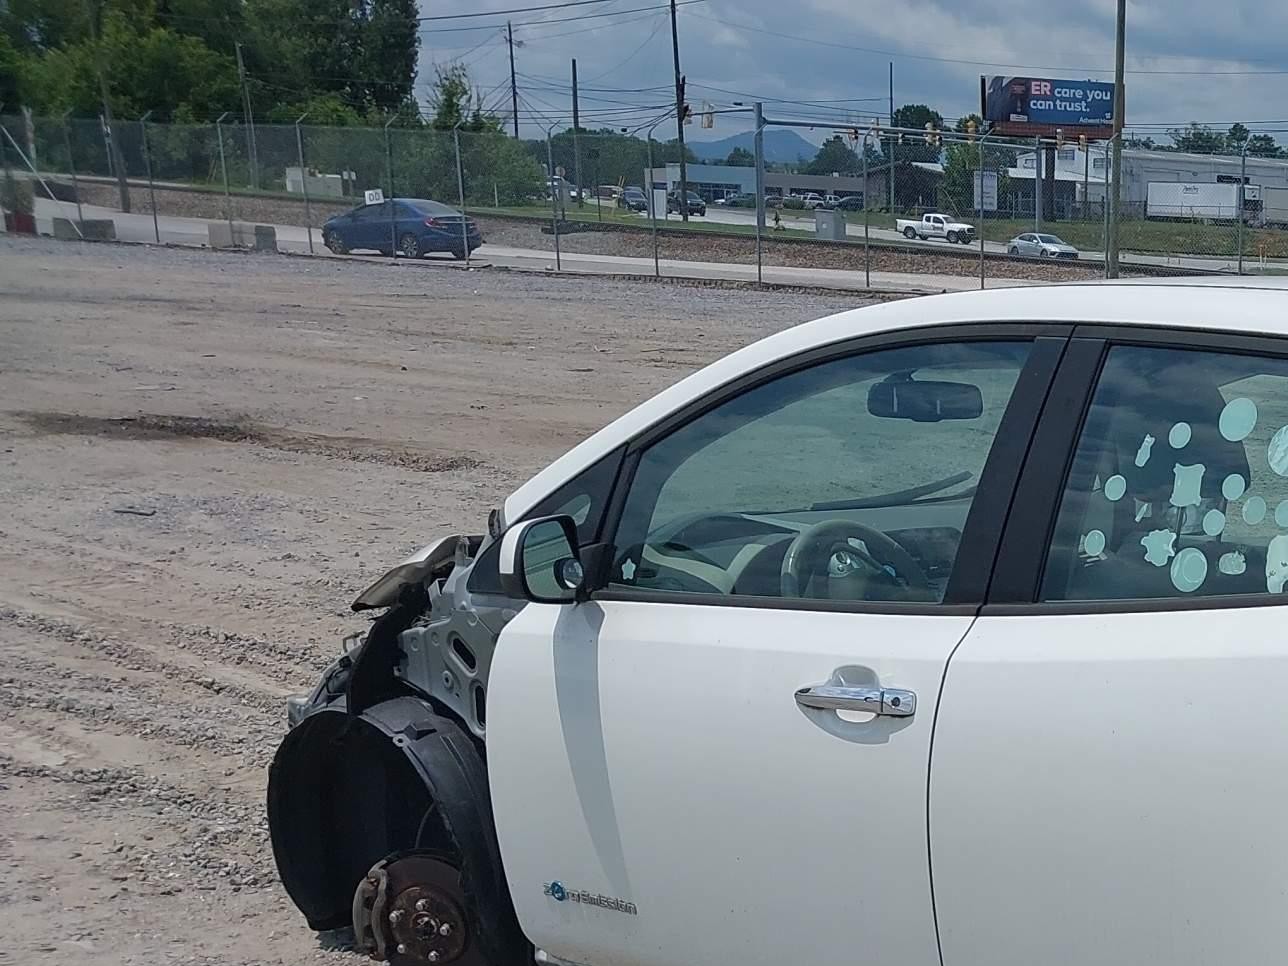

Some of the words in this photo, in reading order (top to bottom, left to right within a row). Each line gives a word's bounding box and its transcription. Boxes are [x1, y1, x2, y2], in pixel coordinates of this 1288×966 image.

[1031, 82, 1051, 95] ER
[1054, 87, 1083, 98] care
[1087, 89, 1111, 101] you
[1030, 100, 1054, 110] can
[1056, 100, 1090, 112] trust.
